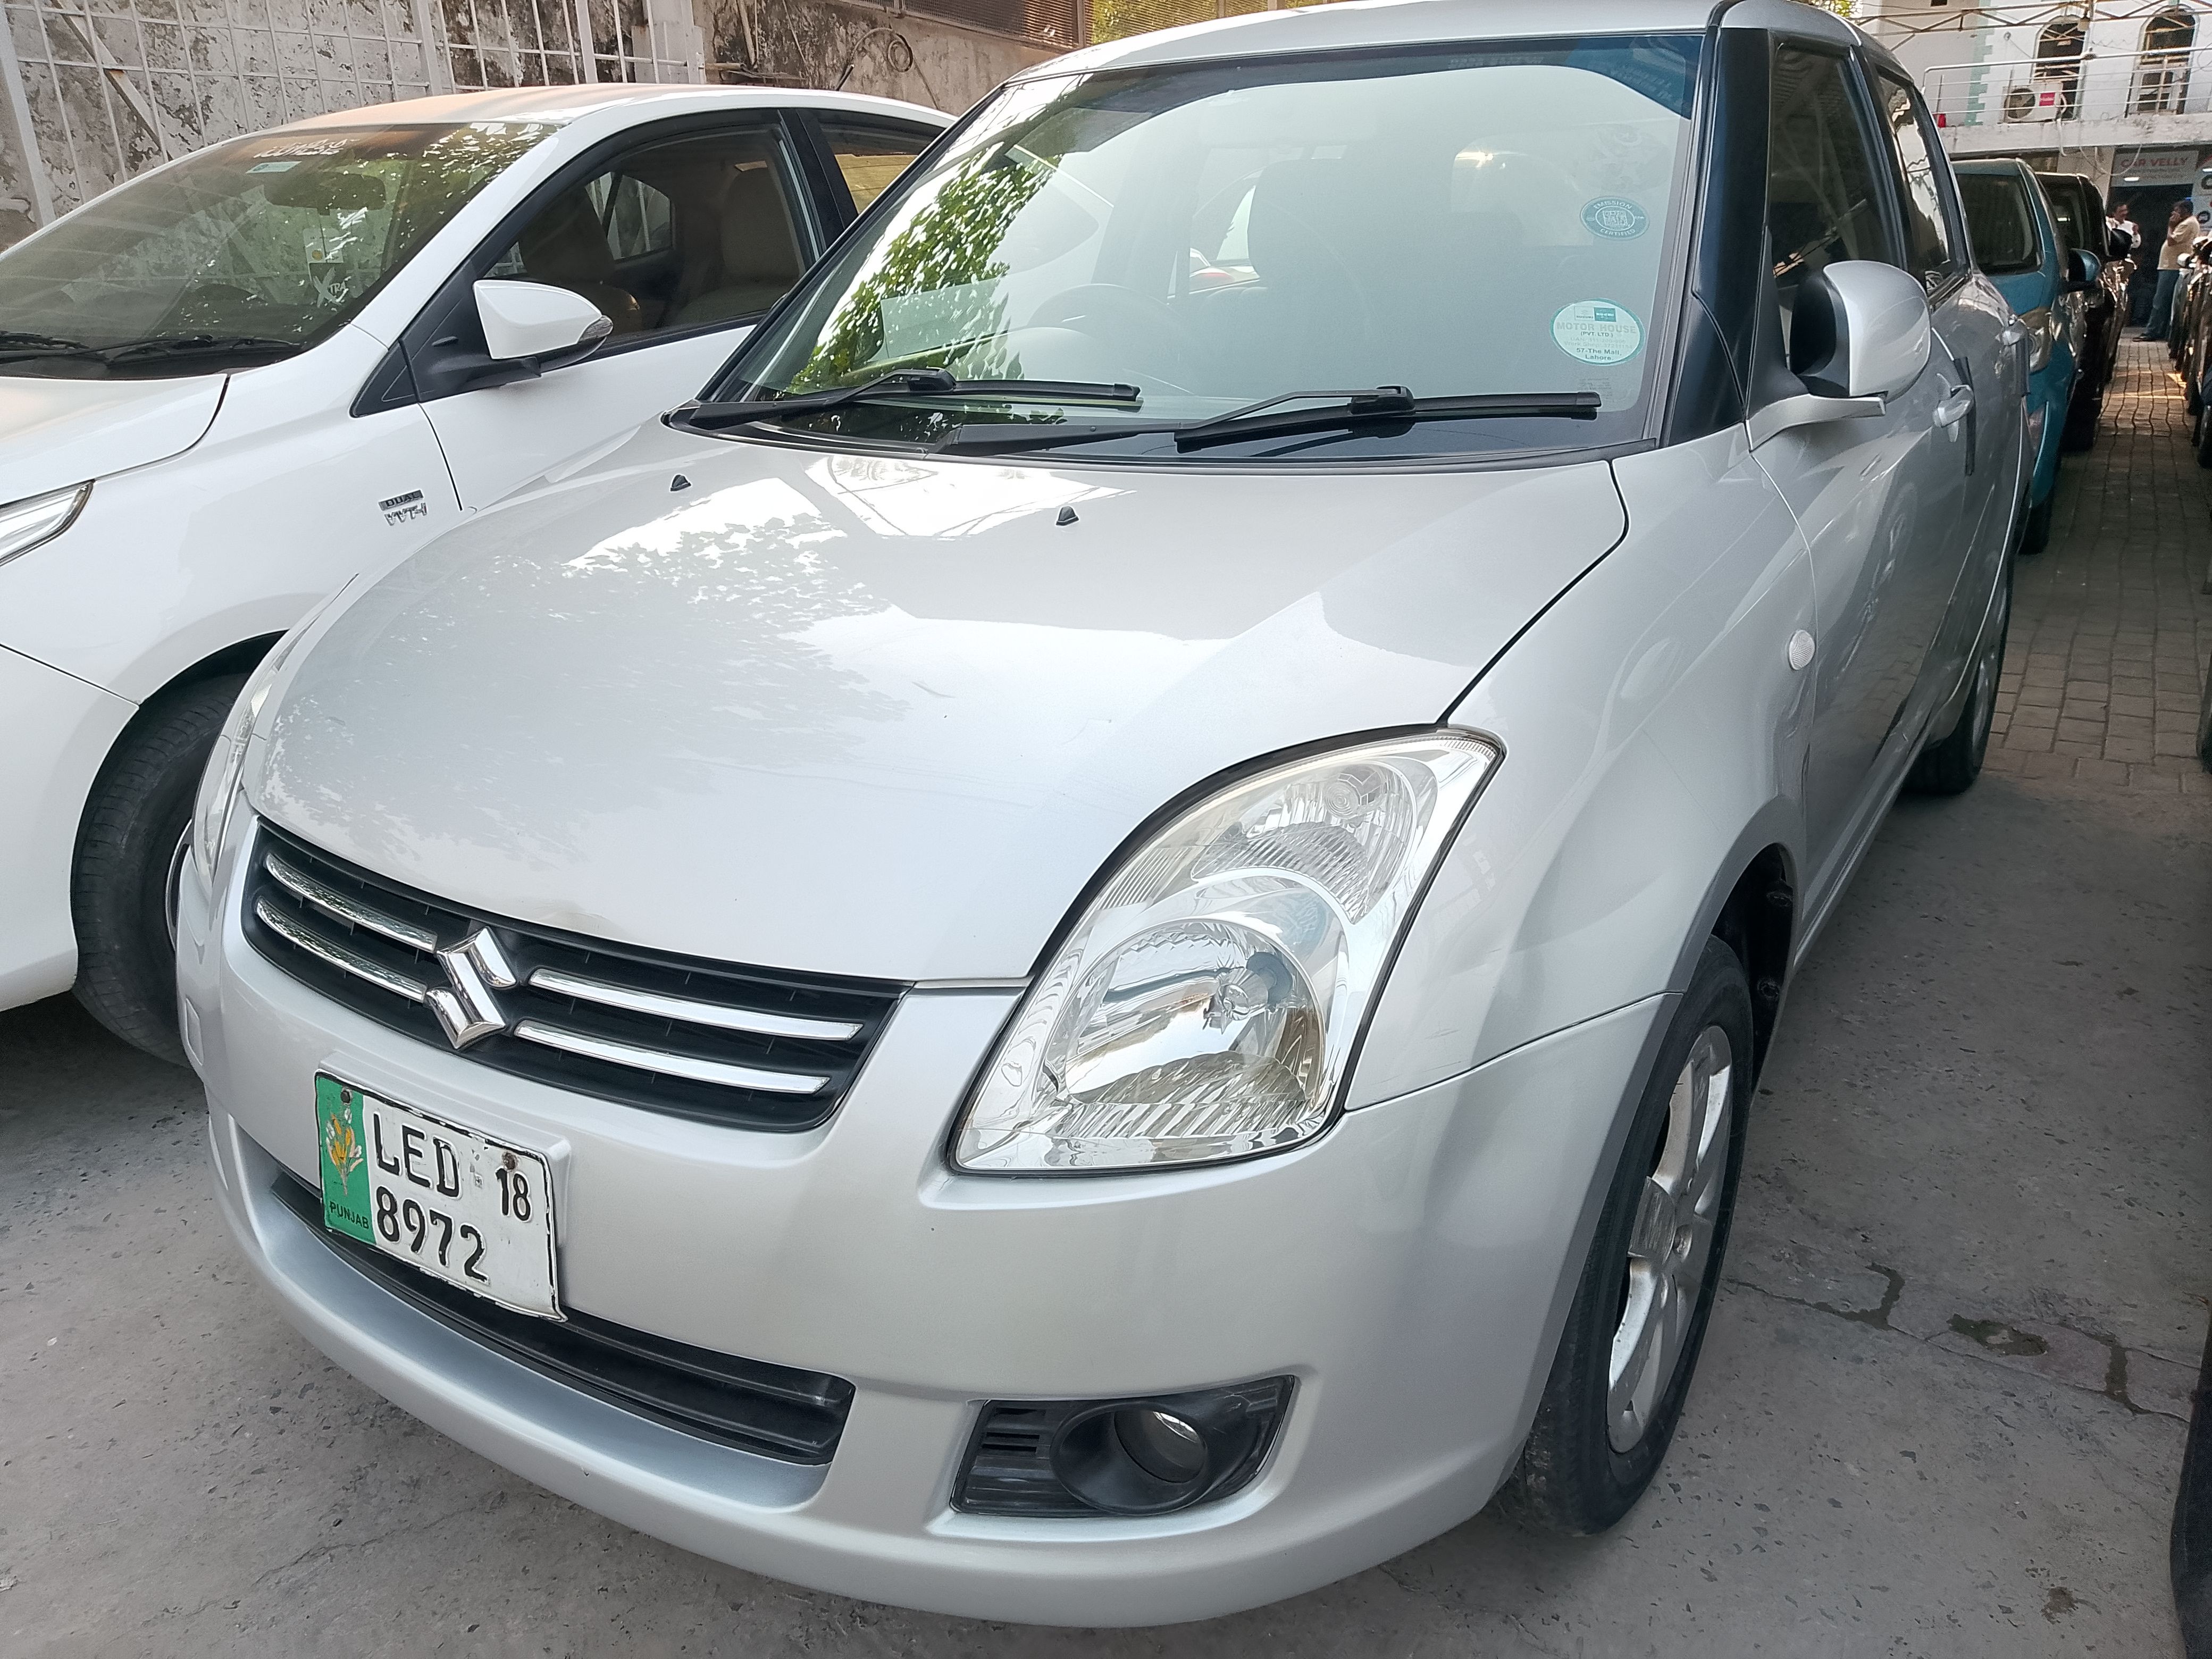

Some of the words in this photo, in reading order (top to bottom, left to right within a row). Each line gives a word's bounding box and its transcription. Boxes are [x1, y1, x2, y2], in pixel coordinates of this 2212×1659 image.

[1593, 200, 1632, 210] EMISSION
[1557, 322, 1594, 331] MOTOR
[1600, 324, 1637, 333] HOUSE
[385, 492, 421, 507] DUAL
[373, 1112, 460, 1198] LED
[496, 1167, 531, 1221] 18
[329, 1200, 369, 1229] PUNJAB
[376, 1185, 488, 1283] 8972
